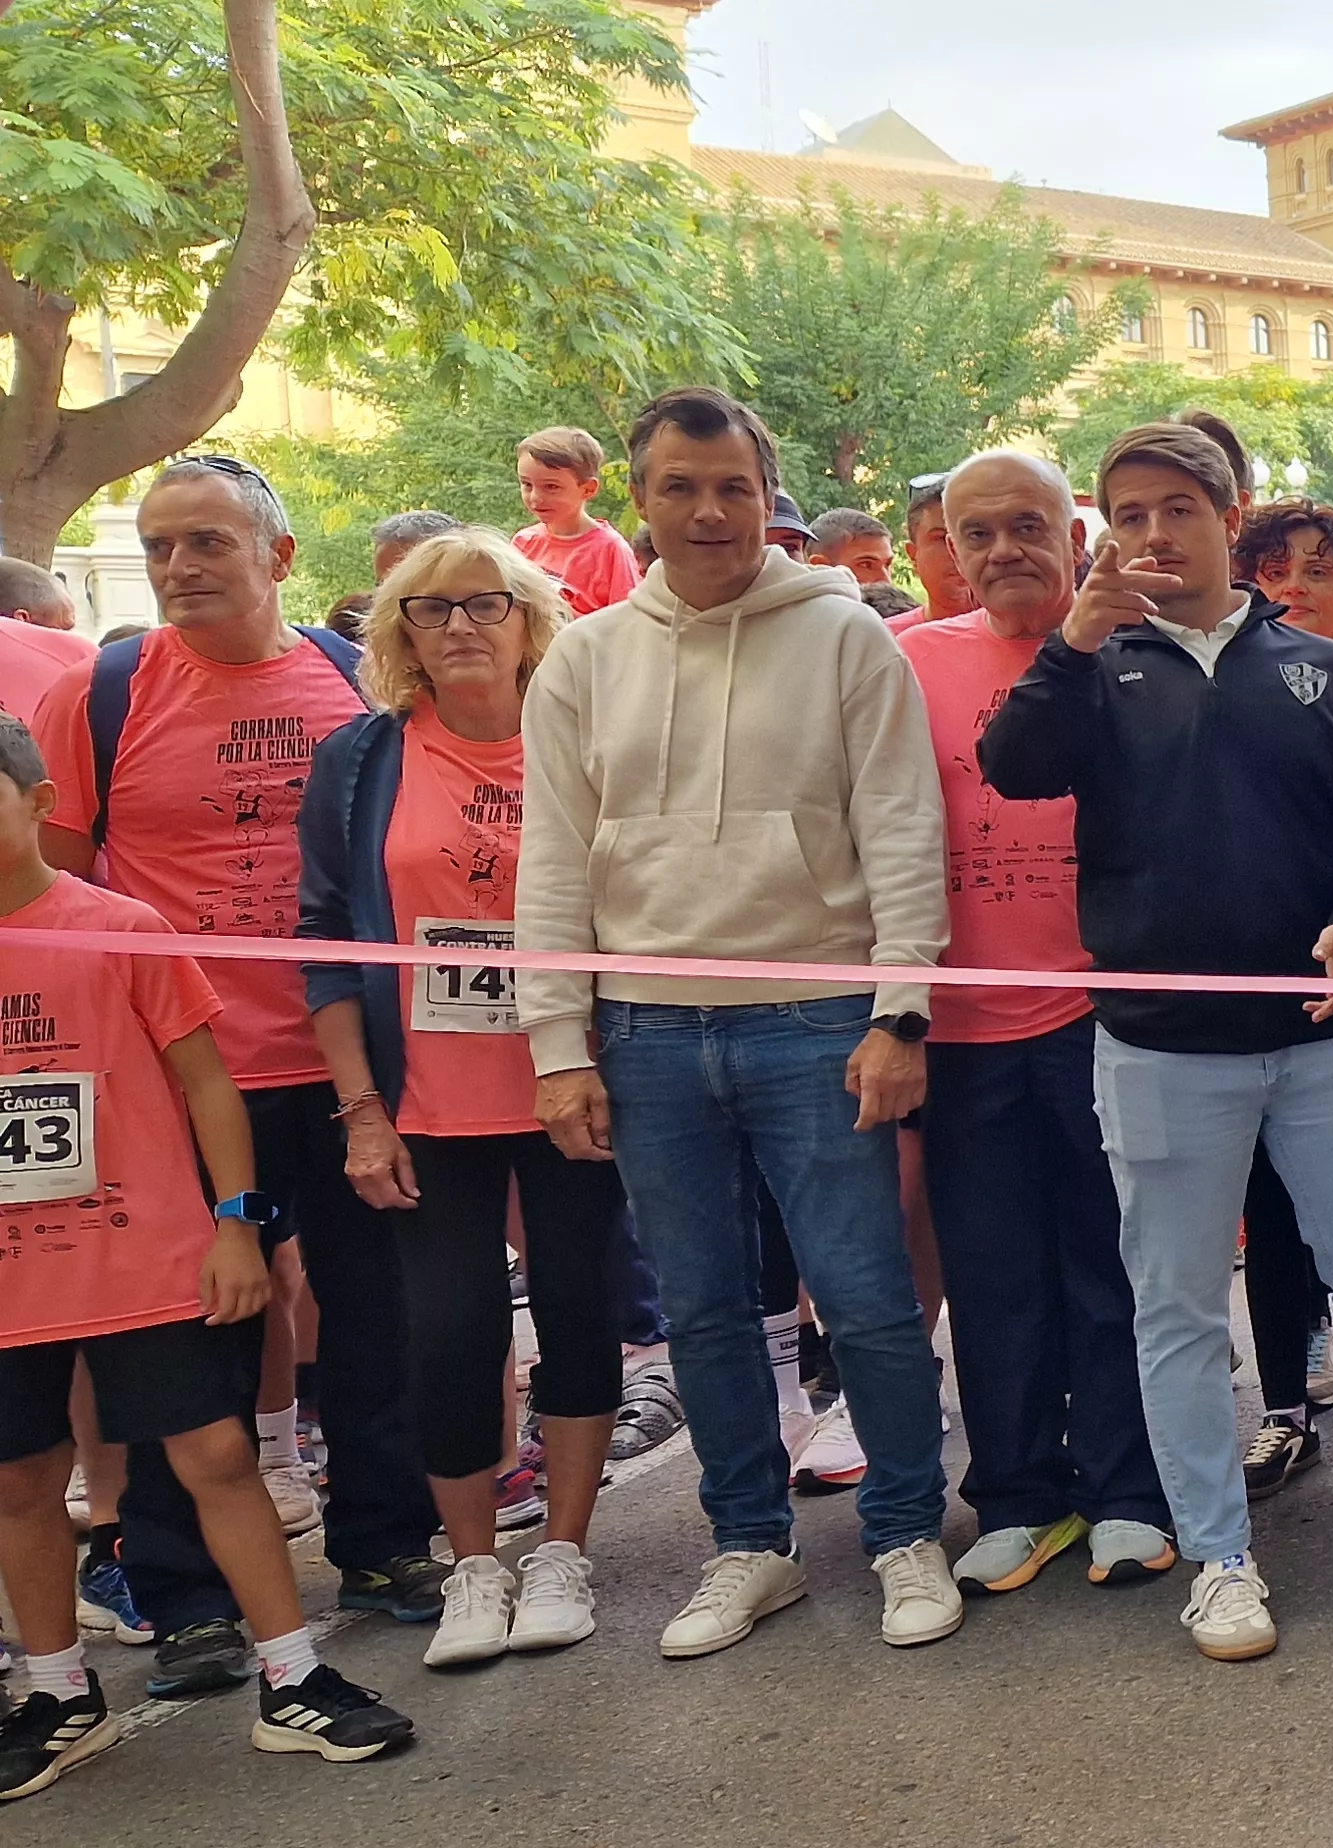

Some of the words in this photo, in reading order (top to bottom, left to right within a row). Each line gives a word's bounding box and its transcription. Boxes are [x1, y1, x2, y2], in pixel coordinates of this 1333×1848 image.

[230, 716, 304, 741] CORRAMOS
[217, 743, 244, 764] POR
[248, 741, 262, 761] LA
[488, 805, 502, 823] LA
[487, 932, 515, 941] HUES
[2, 1017, 56, 1045] CIENCIA
[4, 1096, 70, 1111] CÁNCER
[0, 1115, 73, 1165] 43
